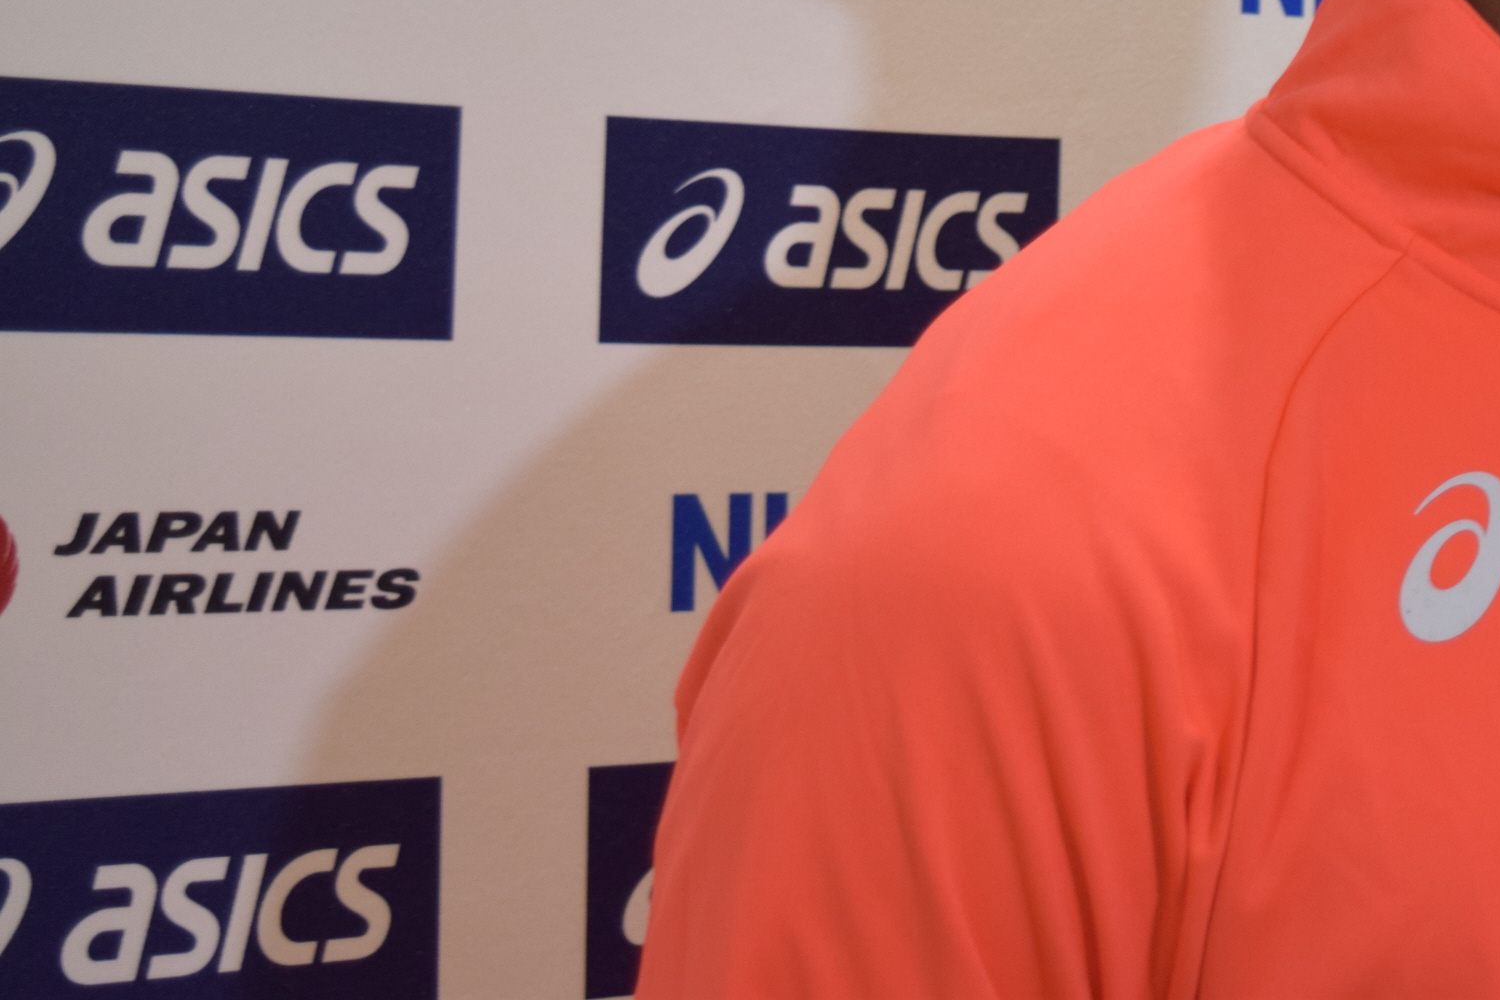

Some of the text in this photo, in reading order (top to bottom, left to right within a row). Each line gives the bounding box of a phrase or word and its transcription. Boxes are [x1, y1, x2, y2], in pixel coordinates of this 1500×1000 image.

[82, 150, 420, 276] asics
[53, 510, 301, 557] JAPAN
[66, 568, 420, 619] AIRLINES
[60, 843, 400, 986] asics
